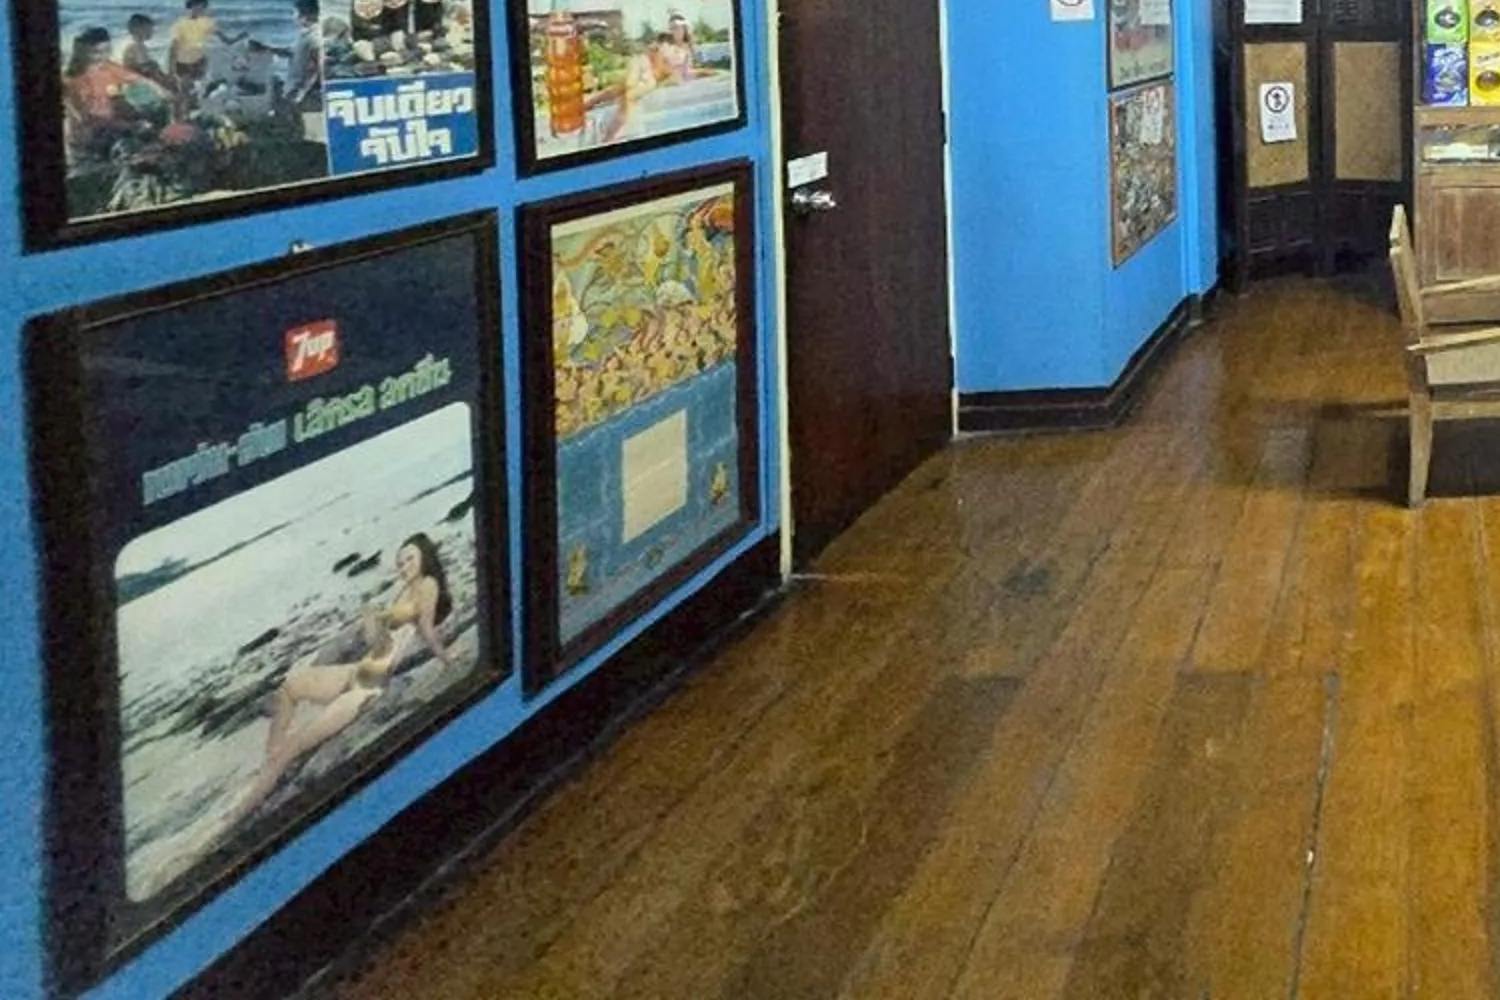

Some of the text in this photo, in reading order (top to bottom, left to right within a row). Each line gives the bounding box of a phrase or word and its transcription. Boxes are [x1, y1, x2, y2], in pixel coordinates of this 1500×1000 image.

[326, 80, 474, 127] จิบเดียว
[360, 119, 452, 164] จับใจ
